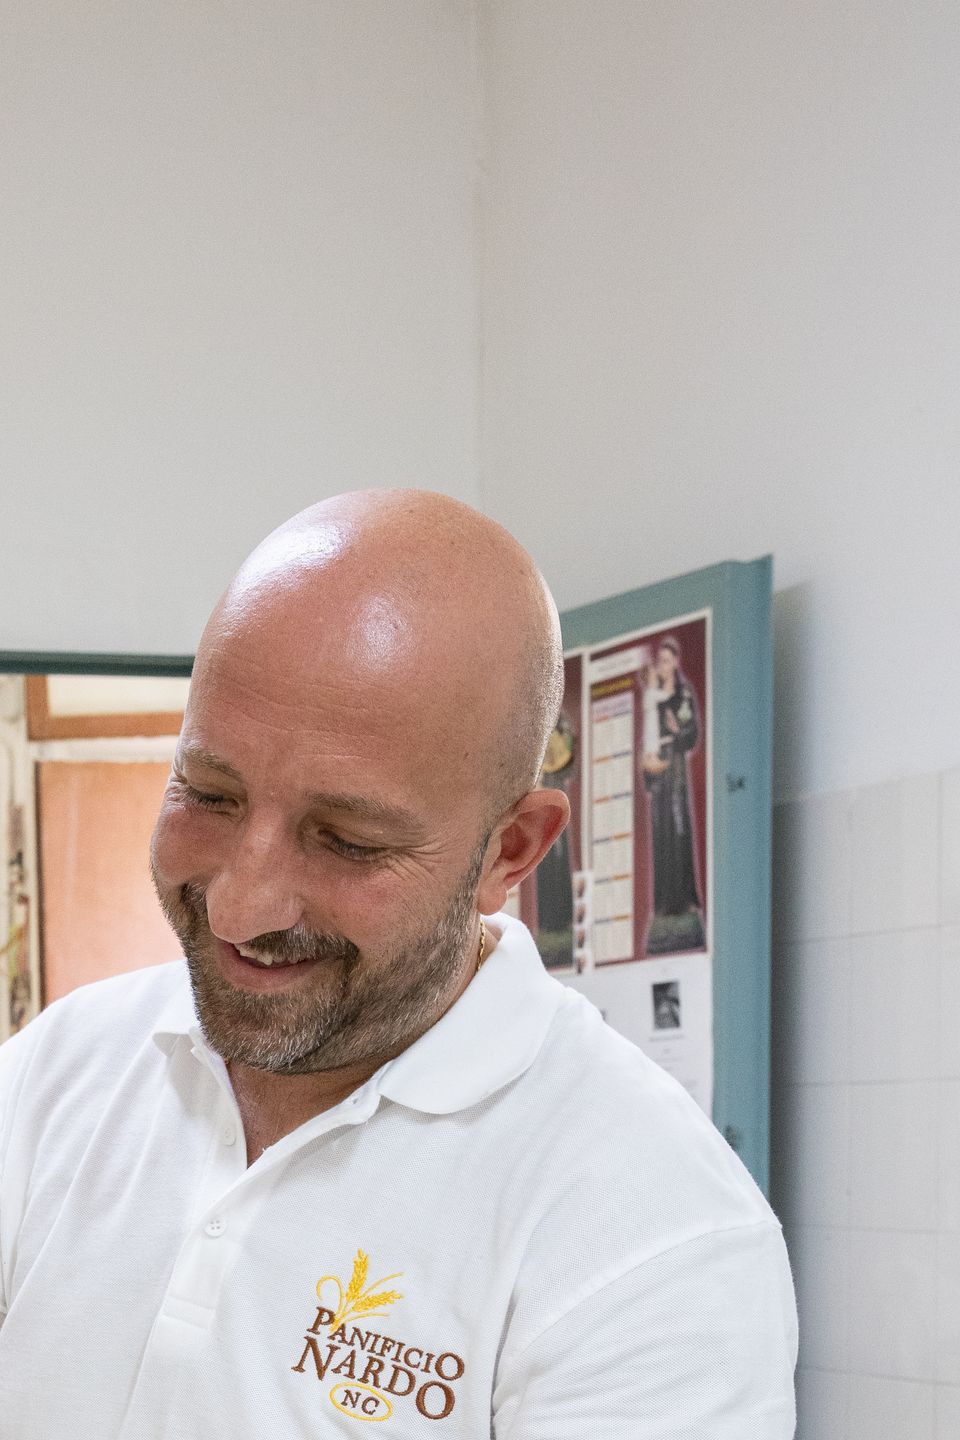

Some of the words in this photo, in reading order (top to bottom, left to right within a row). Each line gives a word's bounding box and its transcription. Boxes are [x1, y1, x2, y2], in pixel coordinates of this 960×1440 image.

[291, 1335, 456, 1421] NARDO
[306, 1306, 466, 1381] PANIFICIO
[340, 1389, 380, 1416] NC
